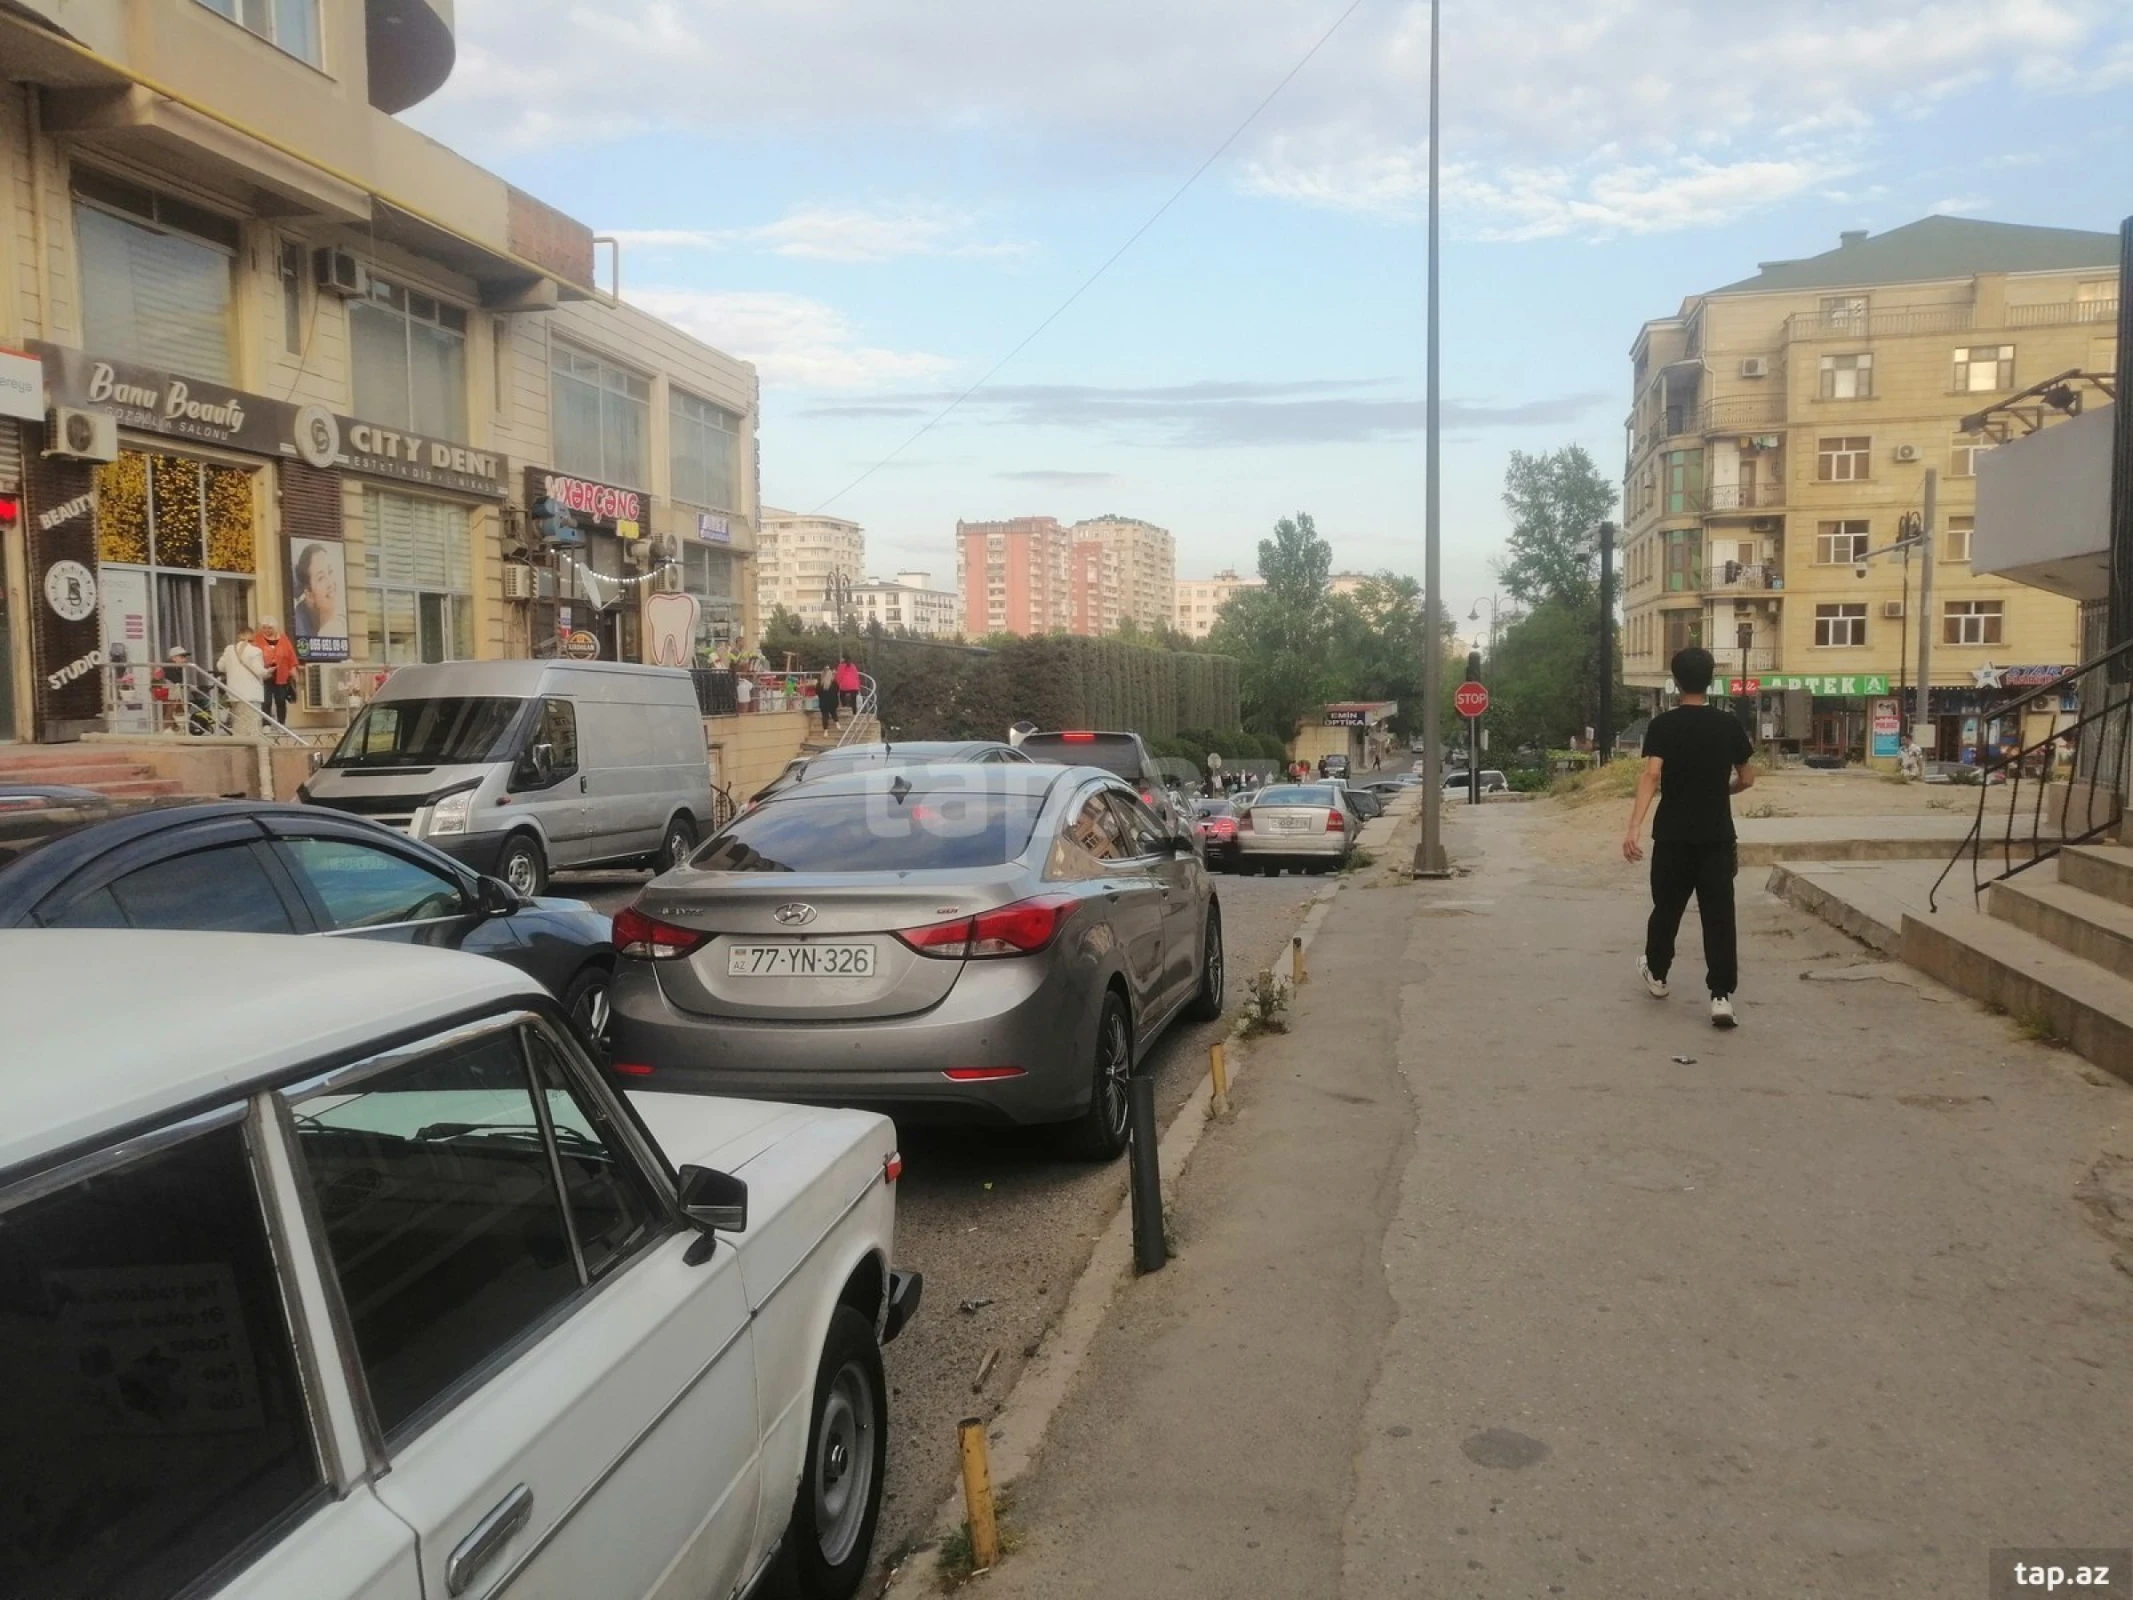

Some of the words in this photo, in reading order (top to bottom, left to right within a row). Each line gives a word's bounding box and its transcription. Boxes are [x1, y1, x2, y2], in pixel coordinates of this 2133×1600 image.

[87, 362, 158, 408] Banu
[164, 380, 245, 433] Beauty
[179, 422, 228, 441] SALONU
[350, 424, 422, 462] CITY
[431, 442, 499, 479] DENT
[39, 492, 96, 530] BEAUTY
[564, 478, 640, 524] XƏRÇƏNG
[48, 650, 101, 690] STUDIO
[1457, 692, 1486, 705] STOP
[733, 960, 745, 970] AZ
[750, 948, 869, 973] 77-YN-326
